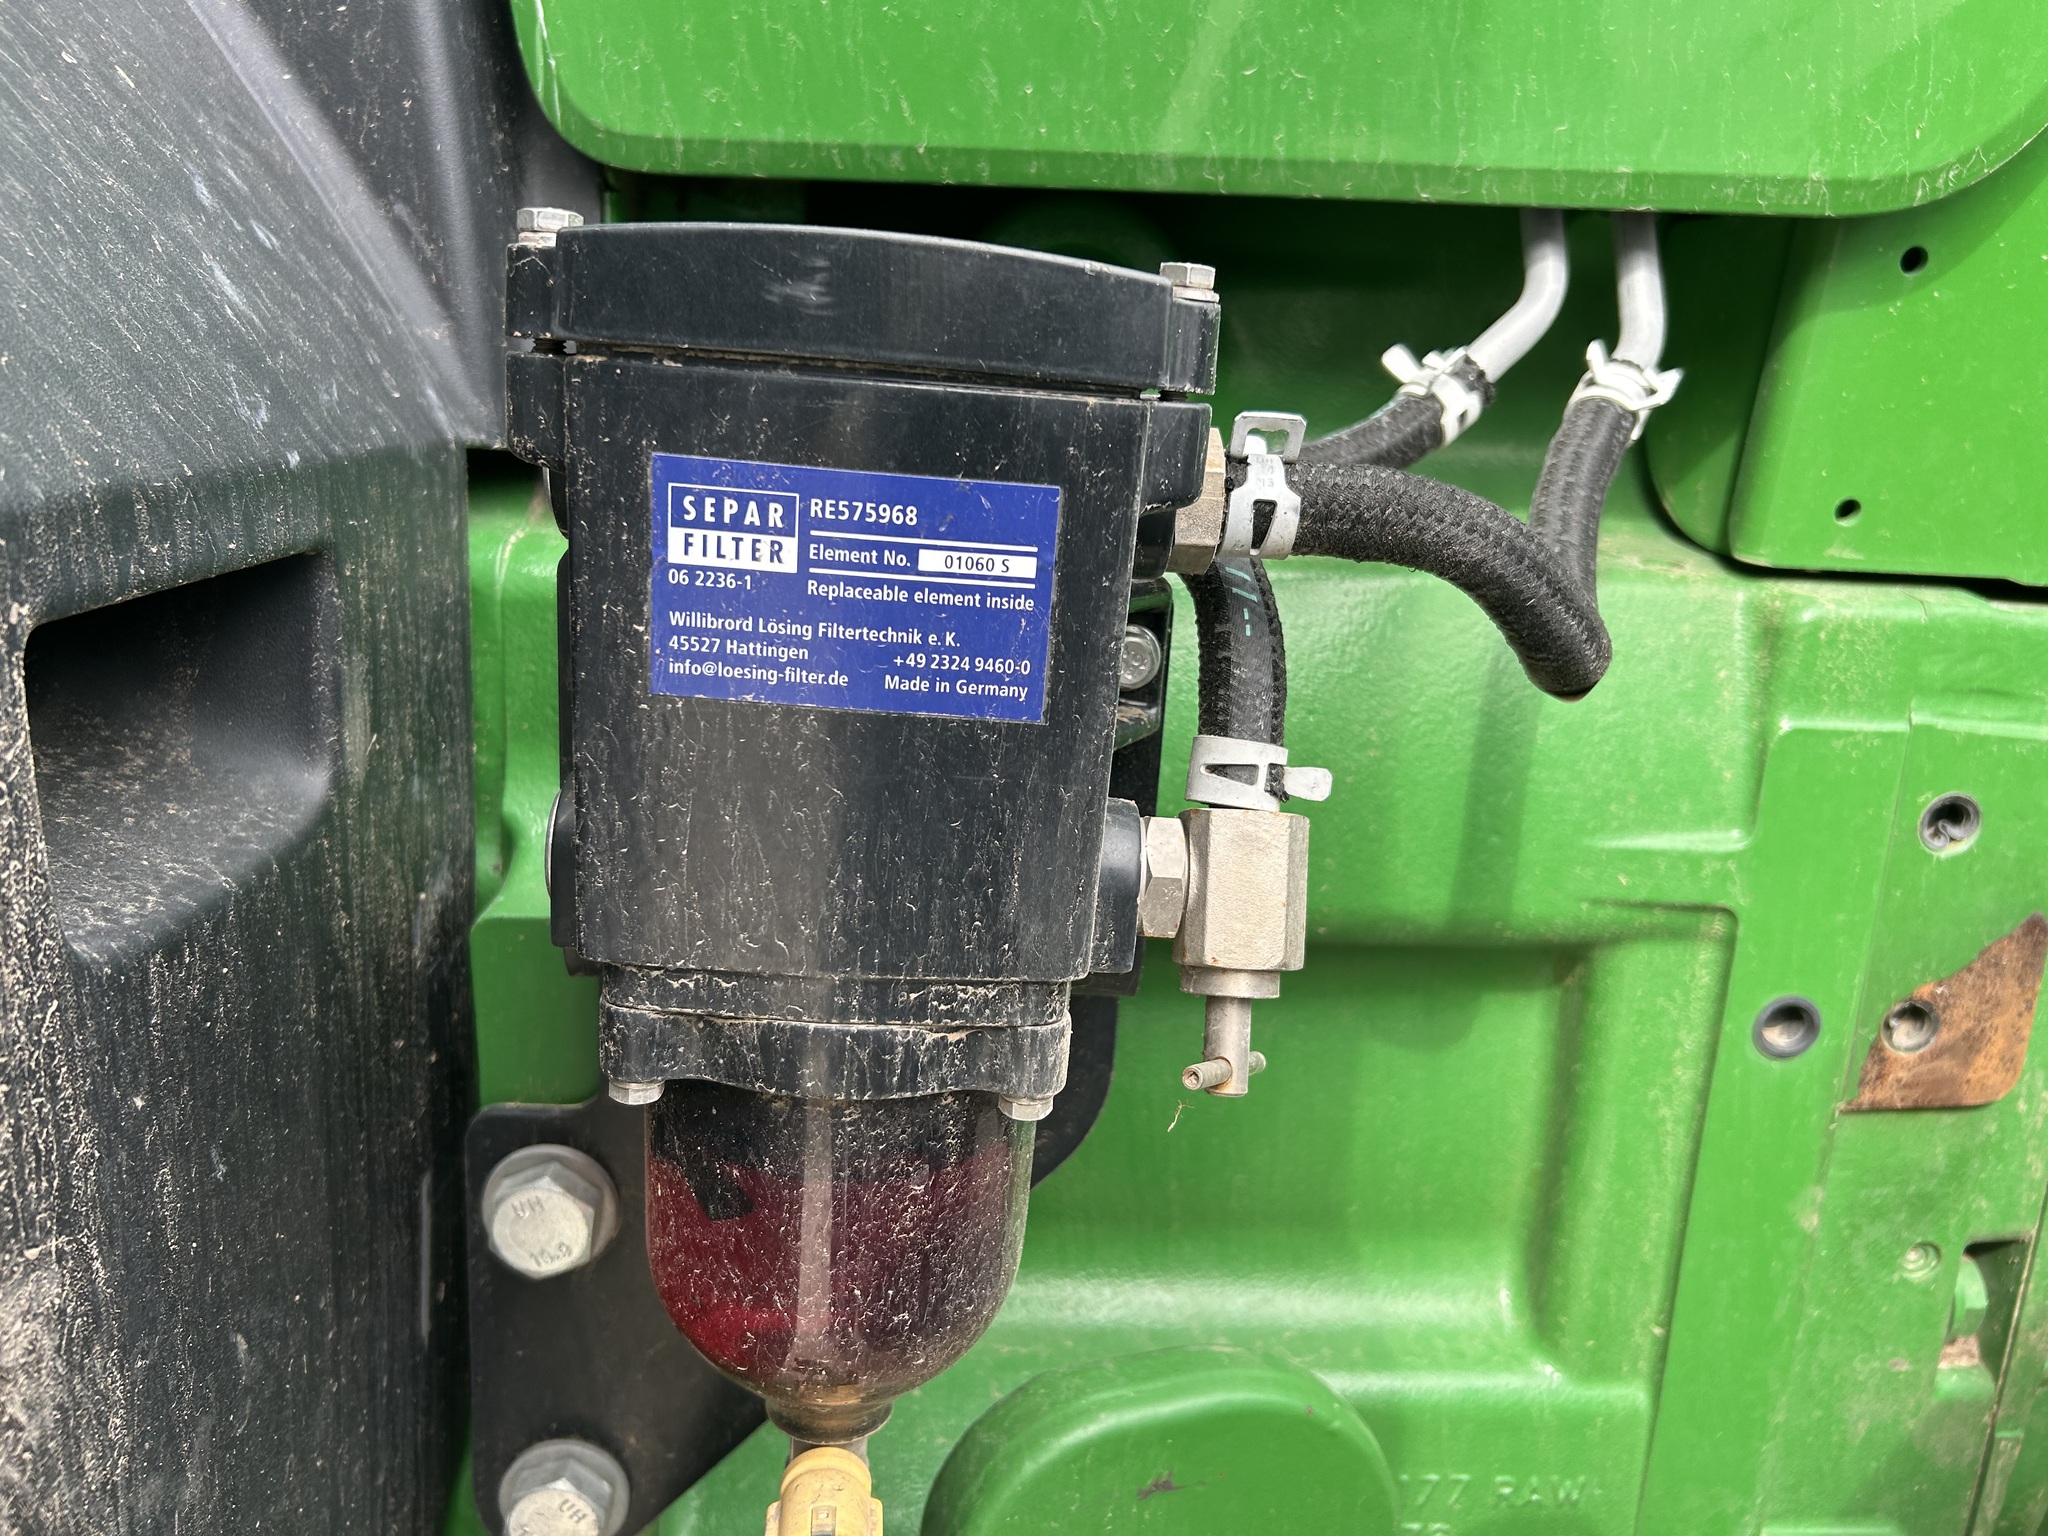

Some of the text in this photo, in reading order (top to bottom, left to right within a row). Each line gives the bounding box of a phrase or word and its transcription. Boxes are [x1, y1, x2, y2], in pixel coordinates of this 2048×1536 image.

[683, 495, 784, 528] SEPAR
[810, 498, 917, 526] RE575968
[684, 530, 785, 563] FILTER
[809, 543, 1009, 572] Element No. 01060 S
[668, 568, 751, 590] 06 2236-1
[807, 579, 1034, 611] Replaceable element inside
[669, 611, 960, 647] Willibrord Lösing Filtertechnik e. K.
[669, 635, 808, 662] 45527 Hattingen
[669, 657, 848, 686] info@loesing-filter.de
[893, 653, 1030, 675] +49 2324 9460-0
[885, 674, 1028, 702] Made in Germany
